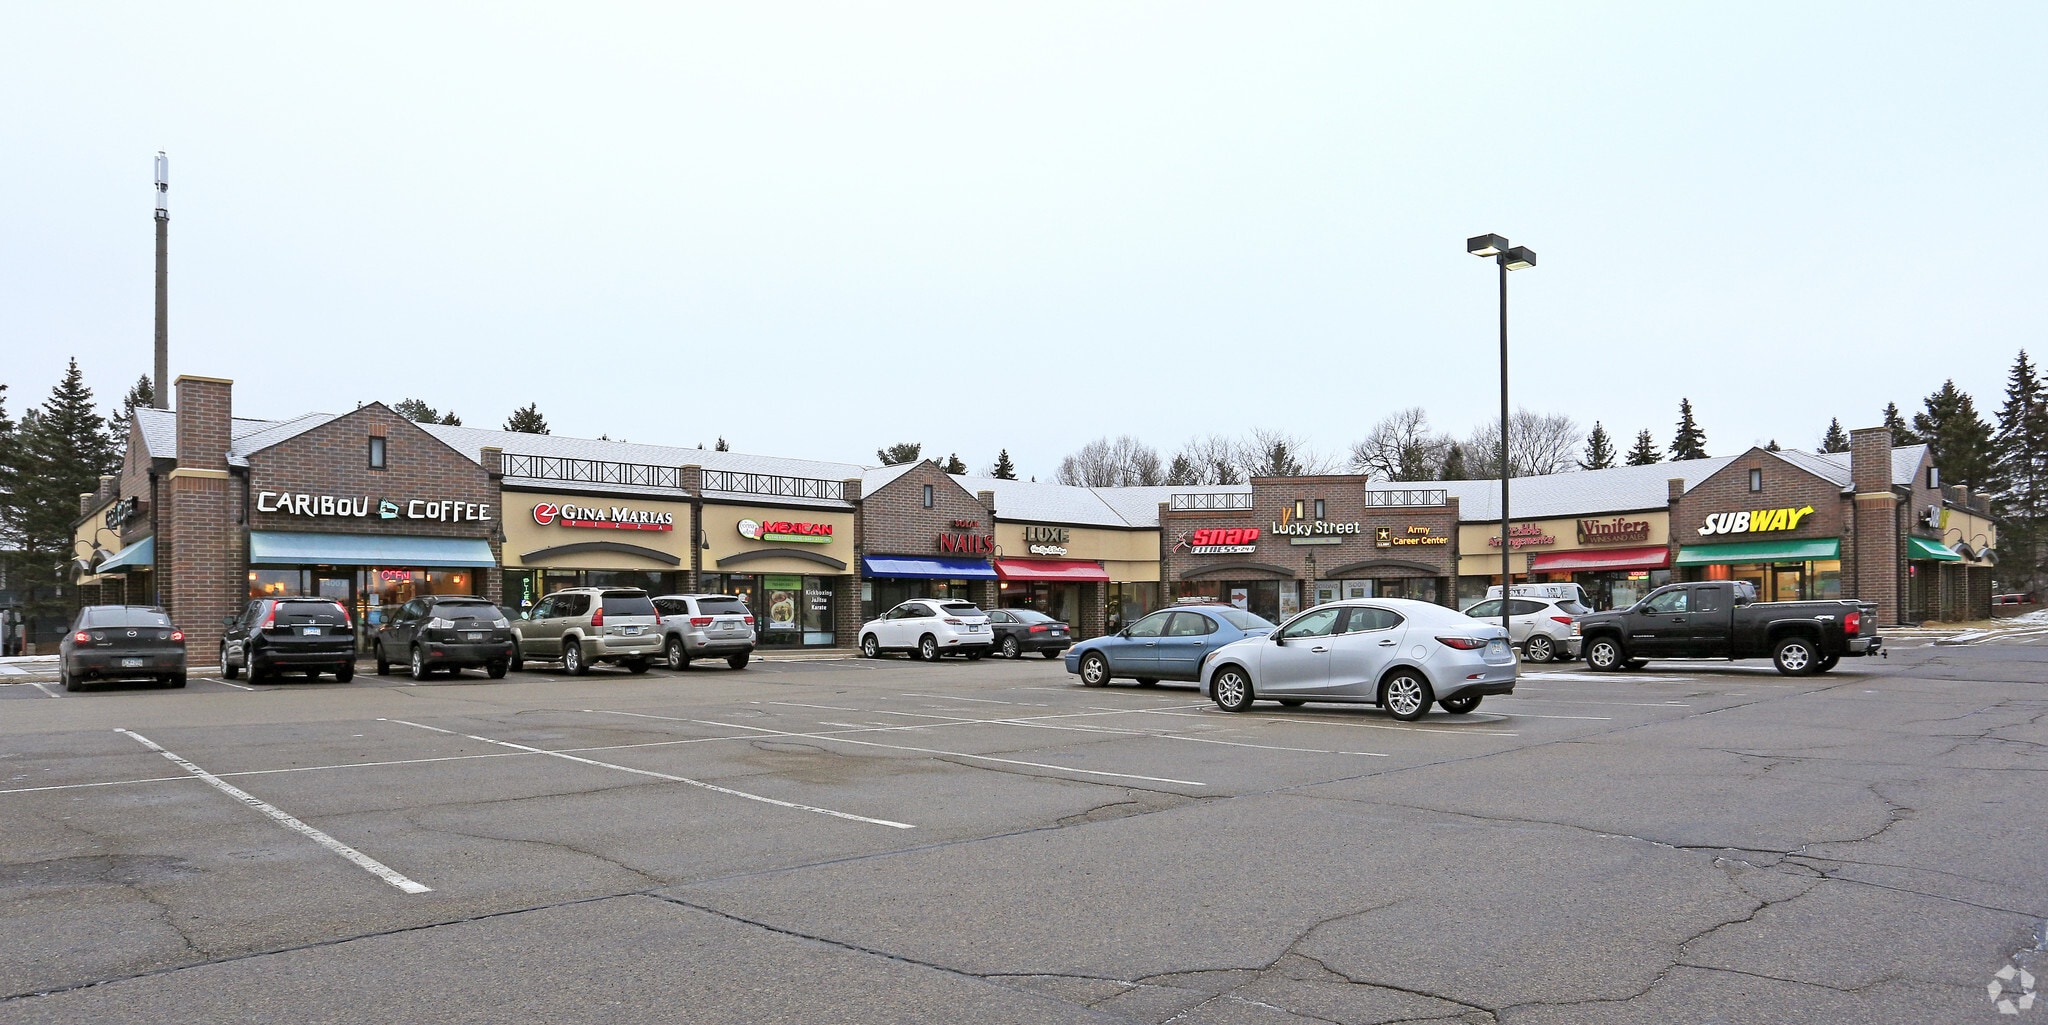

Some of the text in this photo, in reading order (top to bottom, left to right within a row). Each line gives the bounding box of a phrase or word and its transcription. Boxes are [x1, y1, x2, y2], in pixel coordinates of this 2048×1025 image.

[257, 491, 491, 522] CARIBOU COFFEE
[561, 503, 673, 525] GINA MARIAS
[571, 521, 663, 531] PIZZA
[763, 521, 833, 535] MEXICAN
[1315, 520, 1361, 535] Street
[1583, 518, 1650, 536] Vinifera
[1698, 504, 1815, 537] SUBWAY
[1026, 526, 1070, 543] LUXE
[1407, 525, 1431, 535] Army
[1589, 535, 1610, 543] WINES
[1628, 533, 1646, 541] ALES
[941, 532, 994, 554] NAILS
[1392, 537, 1420, 545] Career
[1421, 536, 1448, 545] Center
